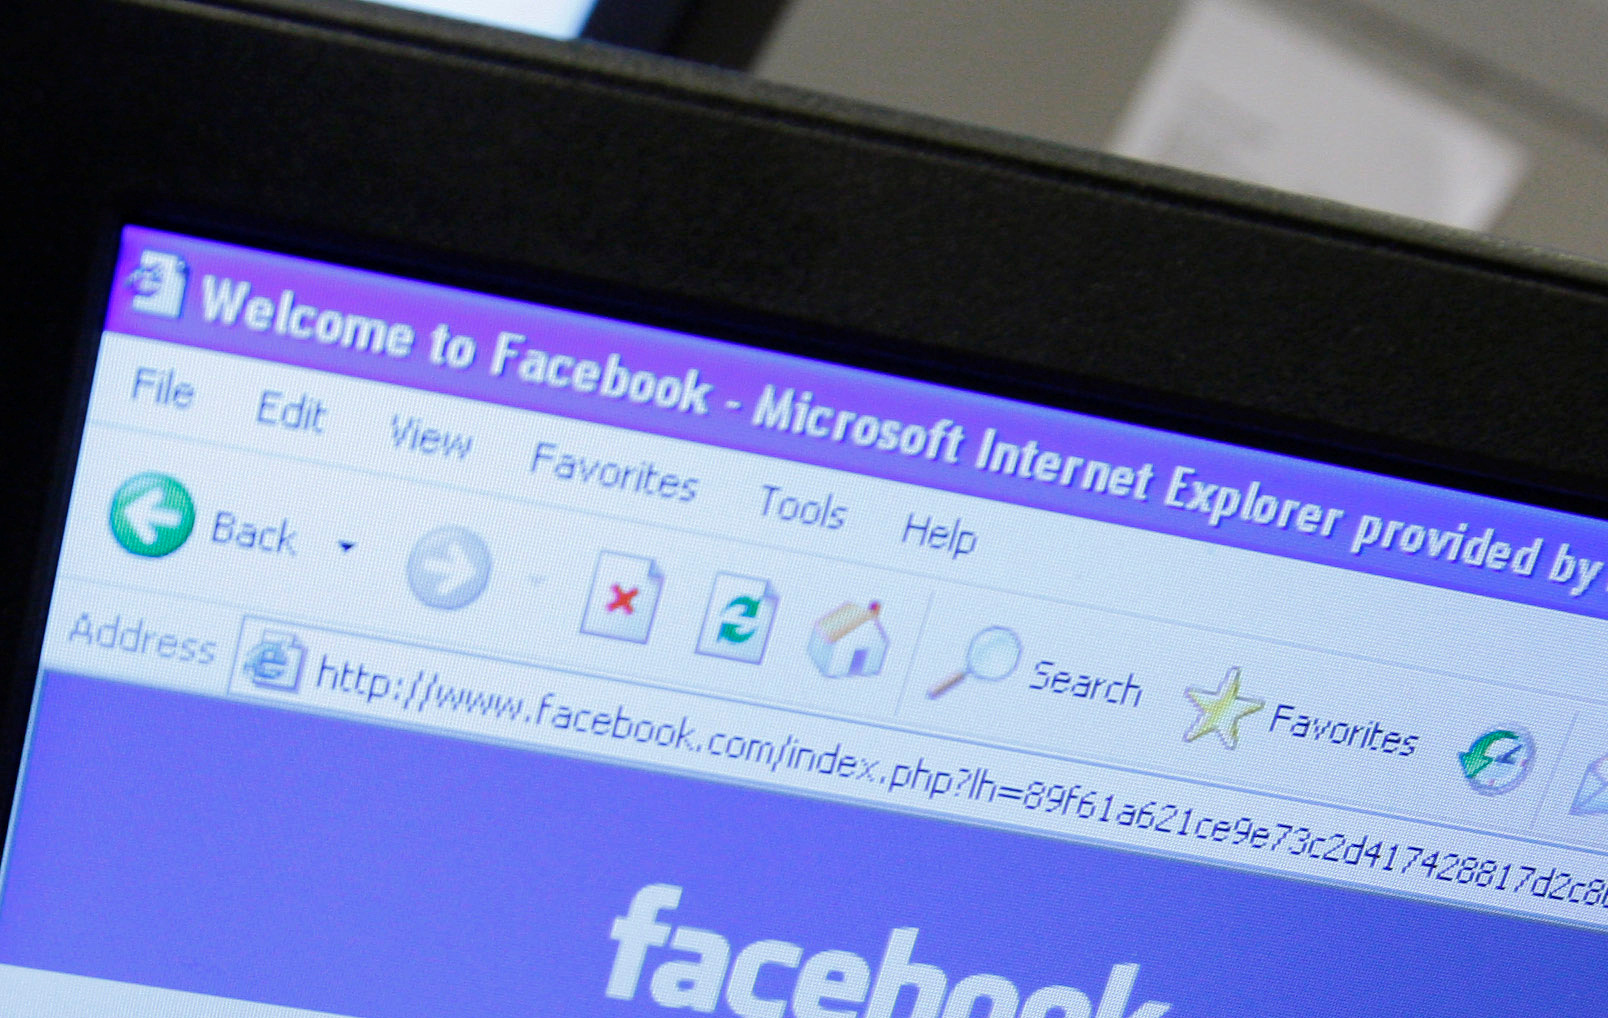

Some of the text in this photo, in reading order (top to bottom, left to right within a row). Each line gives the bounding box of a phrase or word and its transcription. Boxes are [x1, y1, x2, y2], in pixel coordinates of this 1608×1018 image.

[130, 366, 978, 560] File Edit View Favorites Tools Help
[202, 275, 416, 357] Welcome
[429, 322, 476, 369] to
[491, 331, 715, 416] Facebook
[751, 383, 966, 464] Microsoft
[975, 427, 1155, 503] Internet
[1163, 466, 1346, 538] Explorer
[1350, 511, 1544, 576] provided
[1548, 543, 1605, 597] by
[67, 611, 217, 666] Address
[211, 511, 1420, 757] Back Search Favorites
